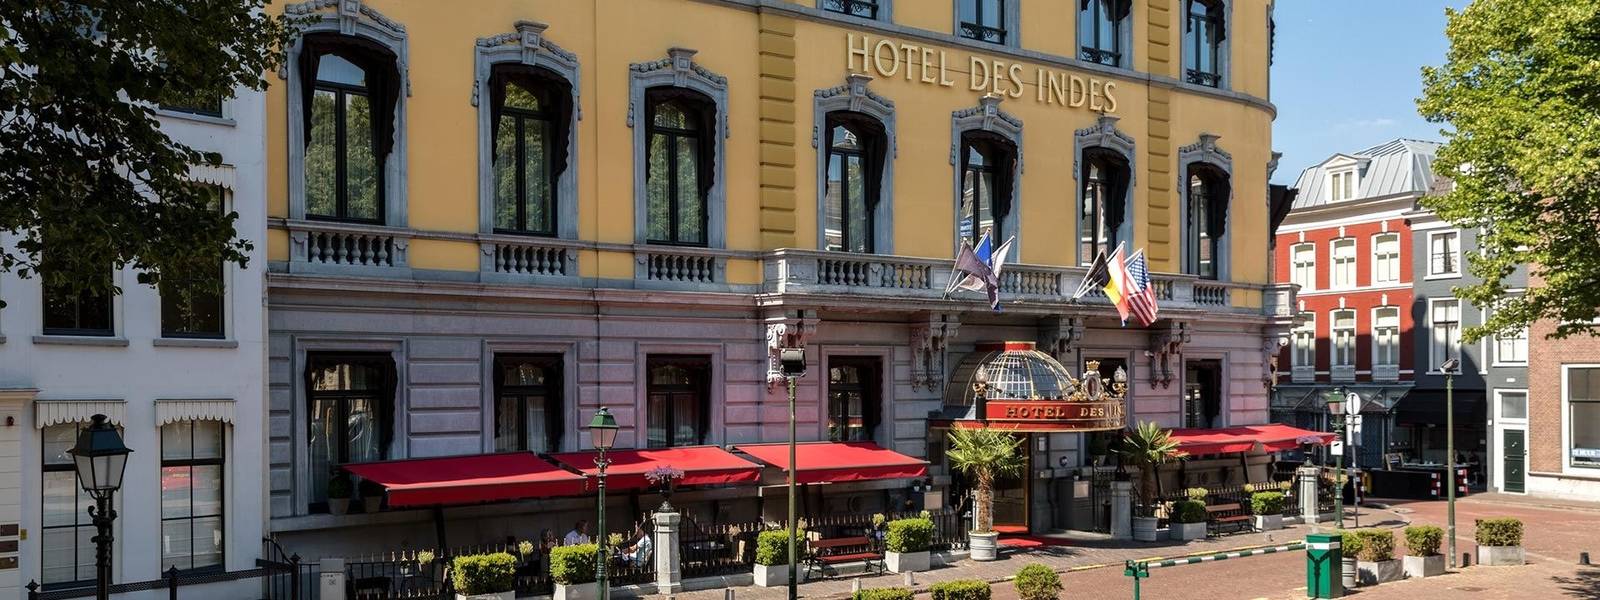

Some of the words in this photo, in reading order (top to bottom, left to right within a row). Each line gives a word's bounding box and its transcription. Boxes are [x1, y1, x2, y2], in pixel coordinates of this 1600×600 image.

[846, 33, 955, 87] HOTEL
[969, 55, 1024, 98] DES
[1036, 67, 1118, 113] INDES
[1006, 406, 1065, 419] HOTEL
[1080, 407, 1105, 417] DES
